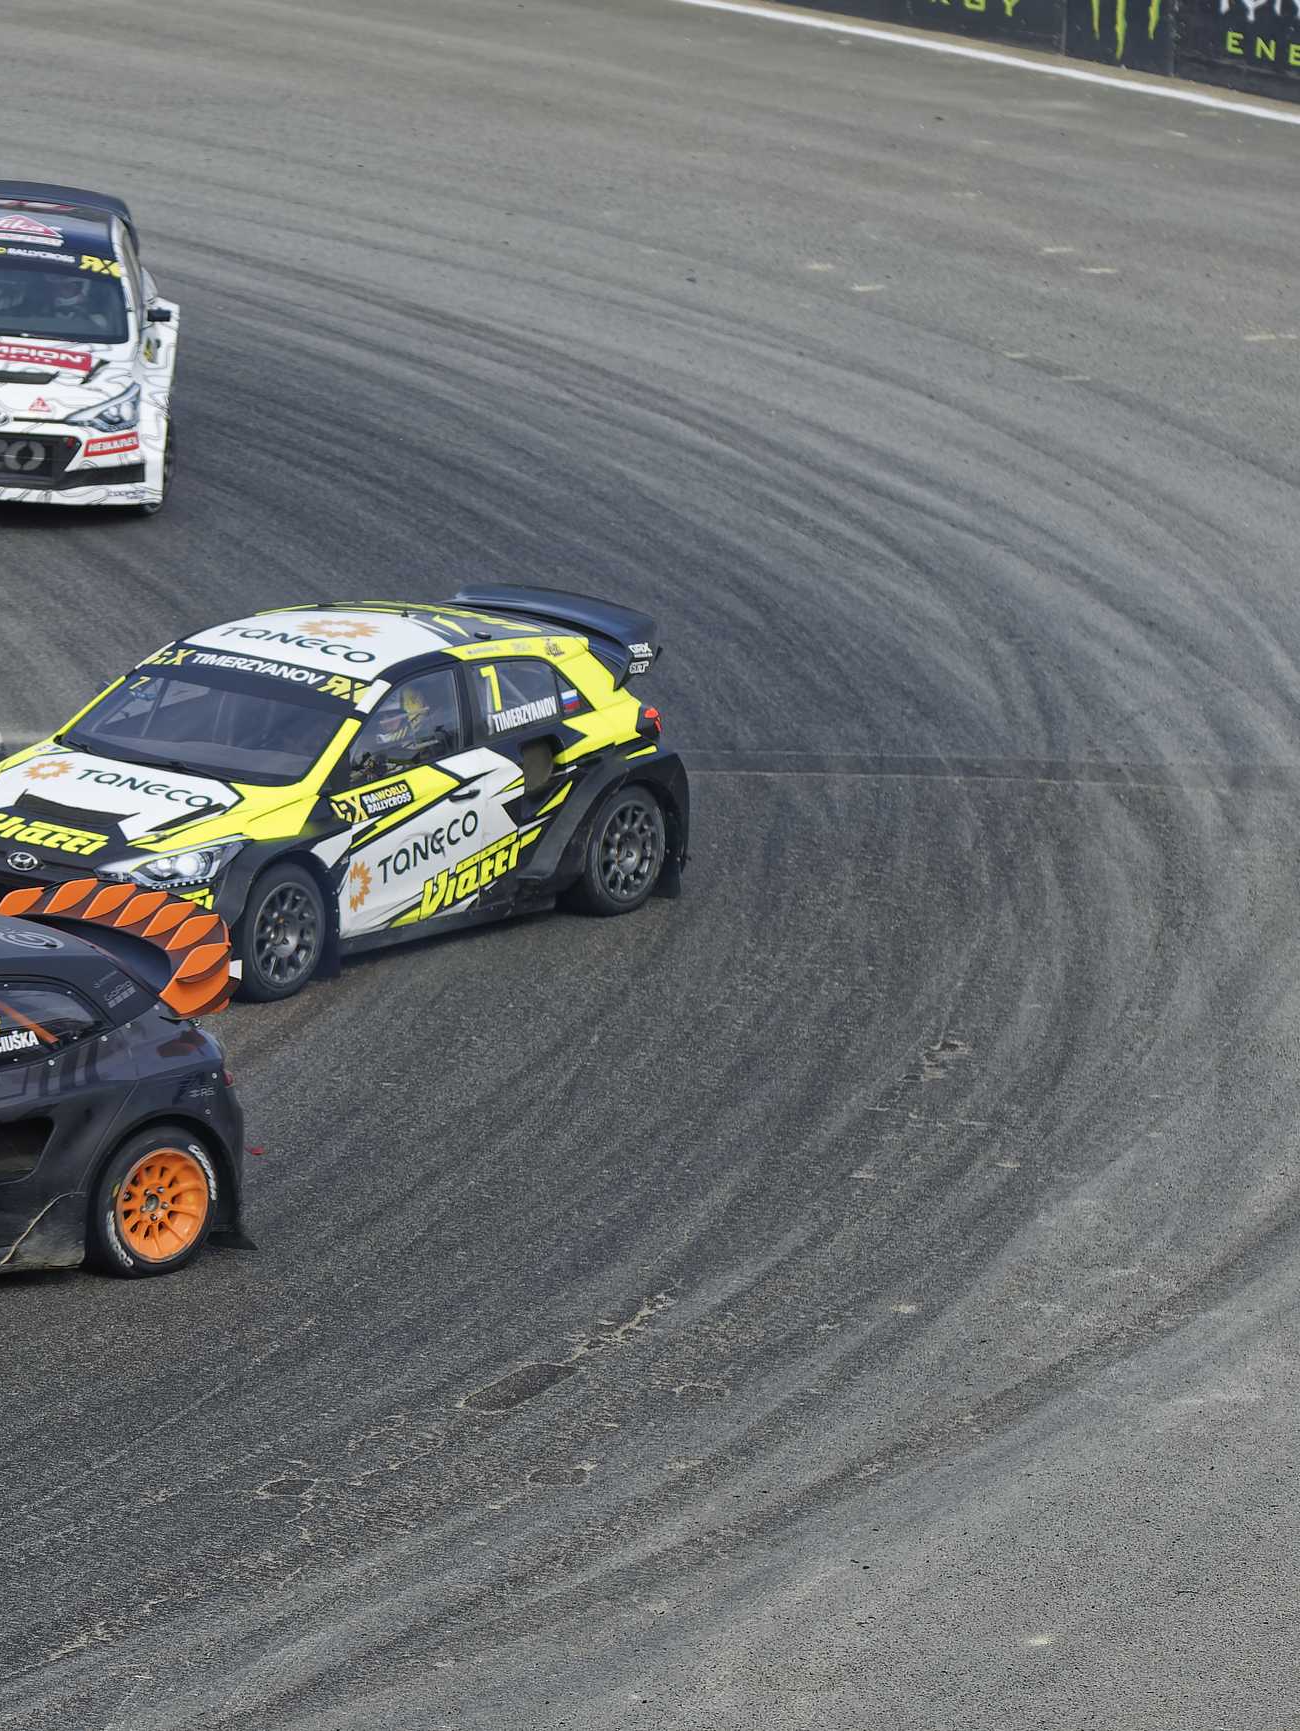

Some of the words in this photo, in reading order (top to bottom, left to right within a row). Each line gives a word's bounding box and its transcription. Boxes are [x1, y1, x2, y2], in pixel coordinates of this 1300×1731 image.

[192, 653, 326, 686] TIMERZYANOV
[493, 695, 557, 733] TIMERZYANOV
[366, 791, 412, 814] RALLYCROSS
[375, 783, 408, 799] WORLD
